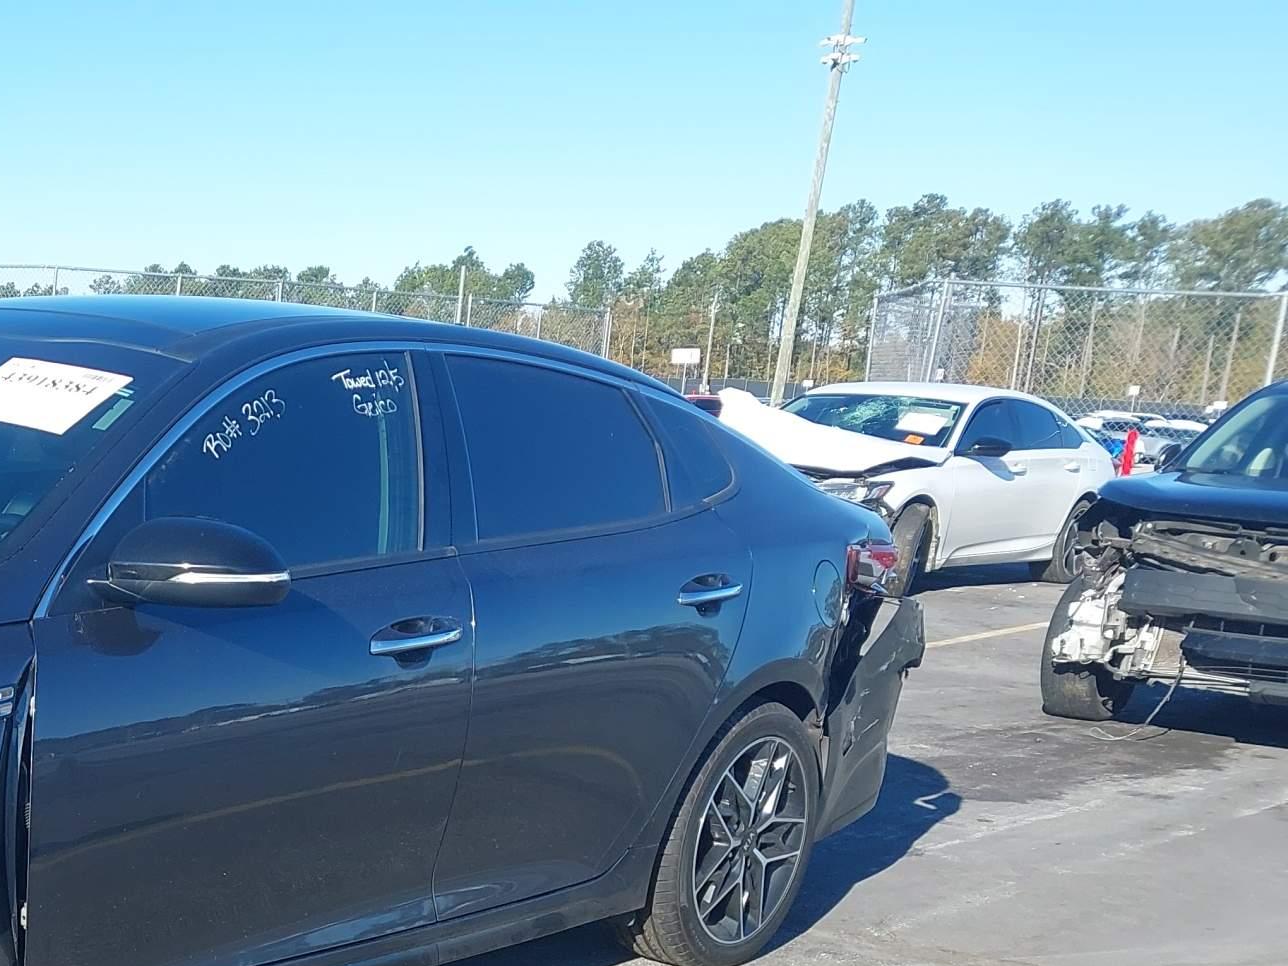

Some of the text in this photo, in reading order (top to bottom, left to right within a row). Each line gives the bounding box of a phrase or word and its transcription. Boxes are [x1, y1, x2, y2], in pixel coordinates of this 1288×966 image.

[1, 371, 99, 396] 43918384
[331, 368, 376, 390] Towed
[241, 389, 286, 436] 3213
